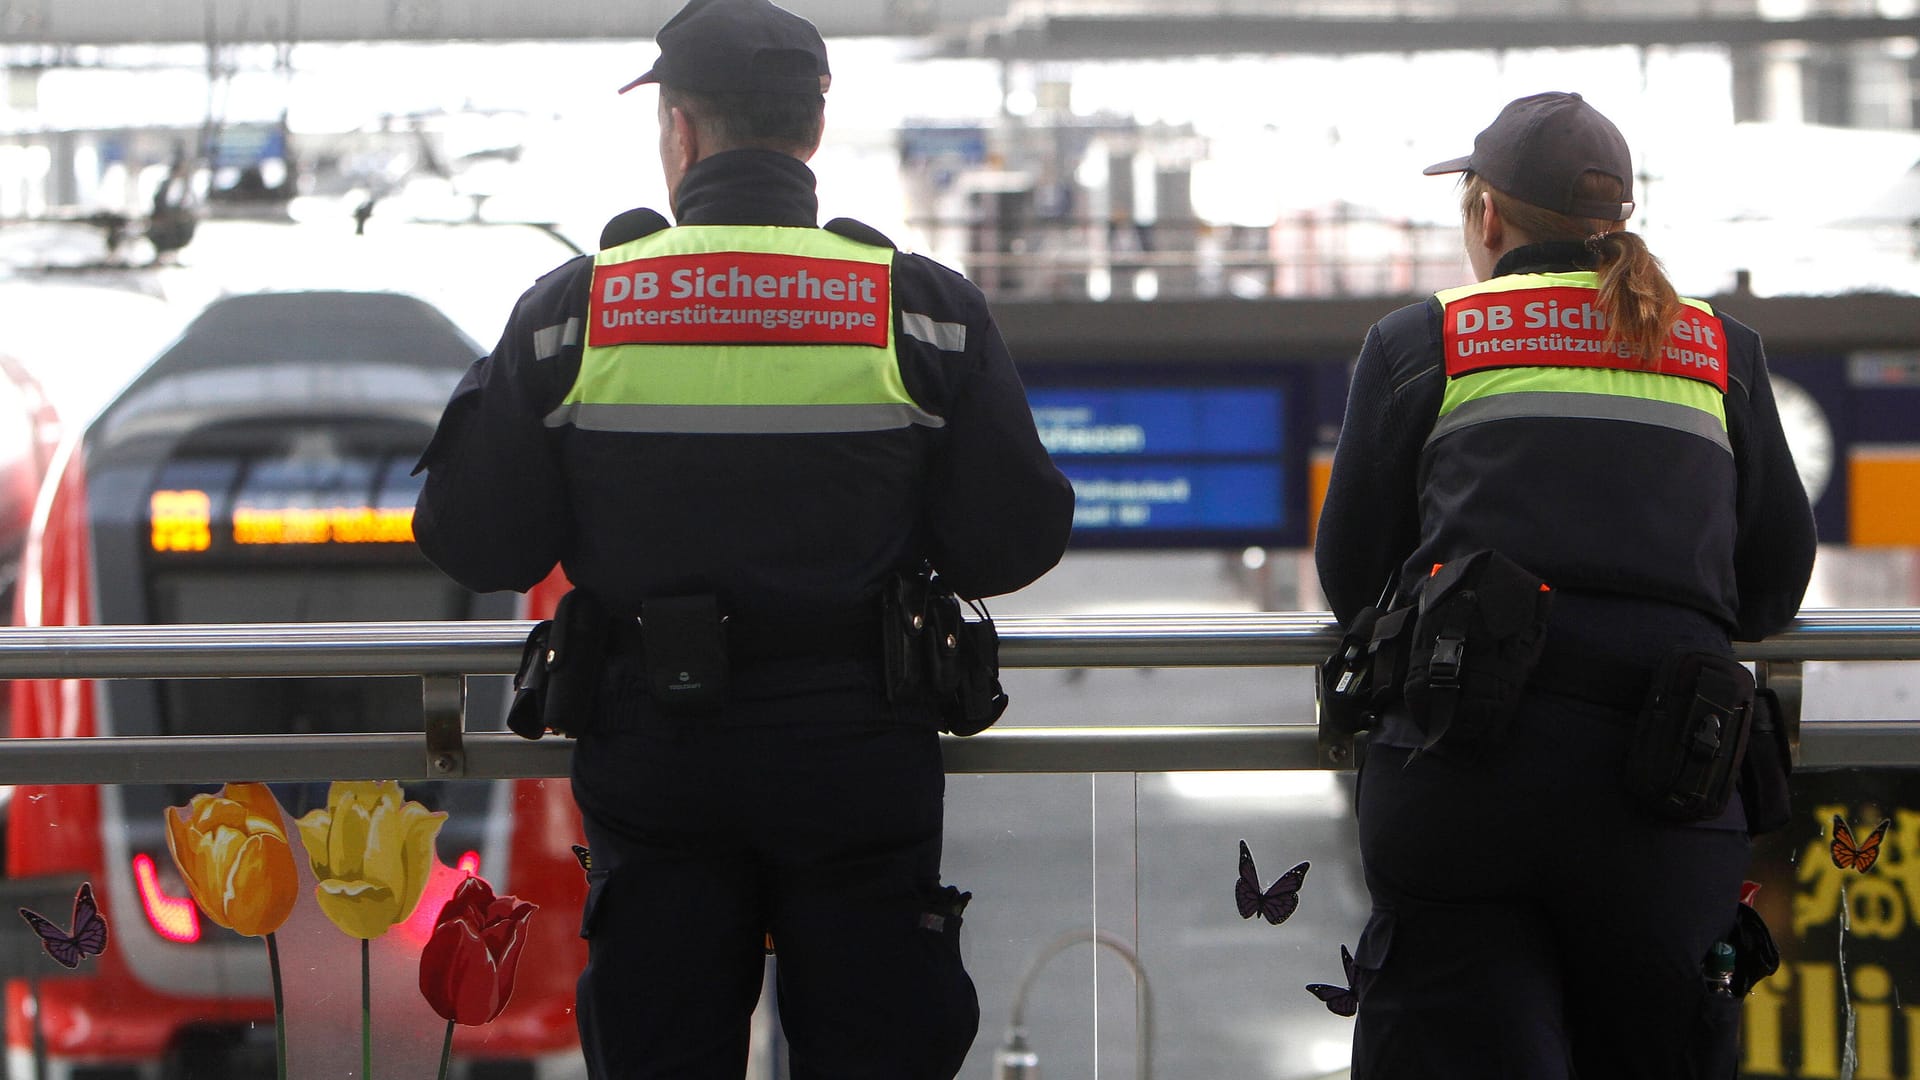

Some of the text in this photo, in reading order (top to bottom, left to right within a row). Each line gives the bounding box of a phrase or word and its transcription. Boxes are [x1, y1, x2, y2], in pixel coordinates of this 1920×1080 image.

[603, 266, 877, 303] DB Sicherheit
[602, 304, 876, 330] Unterstützungsgruppe
[1456, 300, 1718, 349] DB Sicheit
[1457, 333, 1720, 371] Unterstützungsruppe
